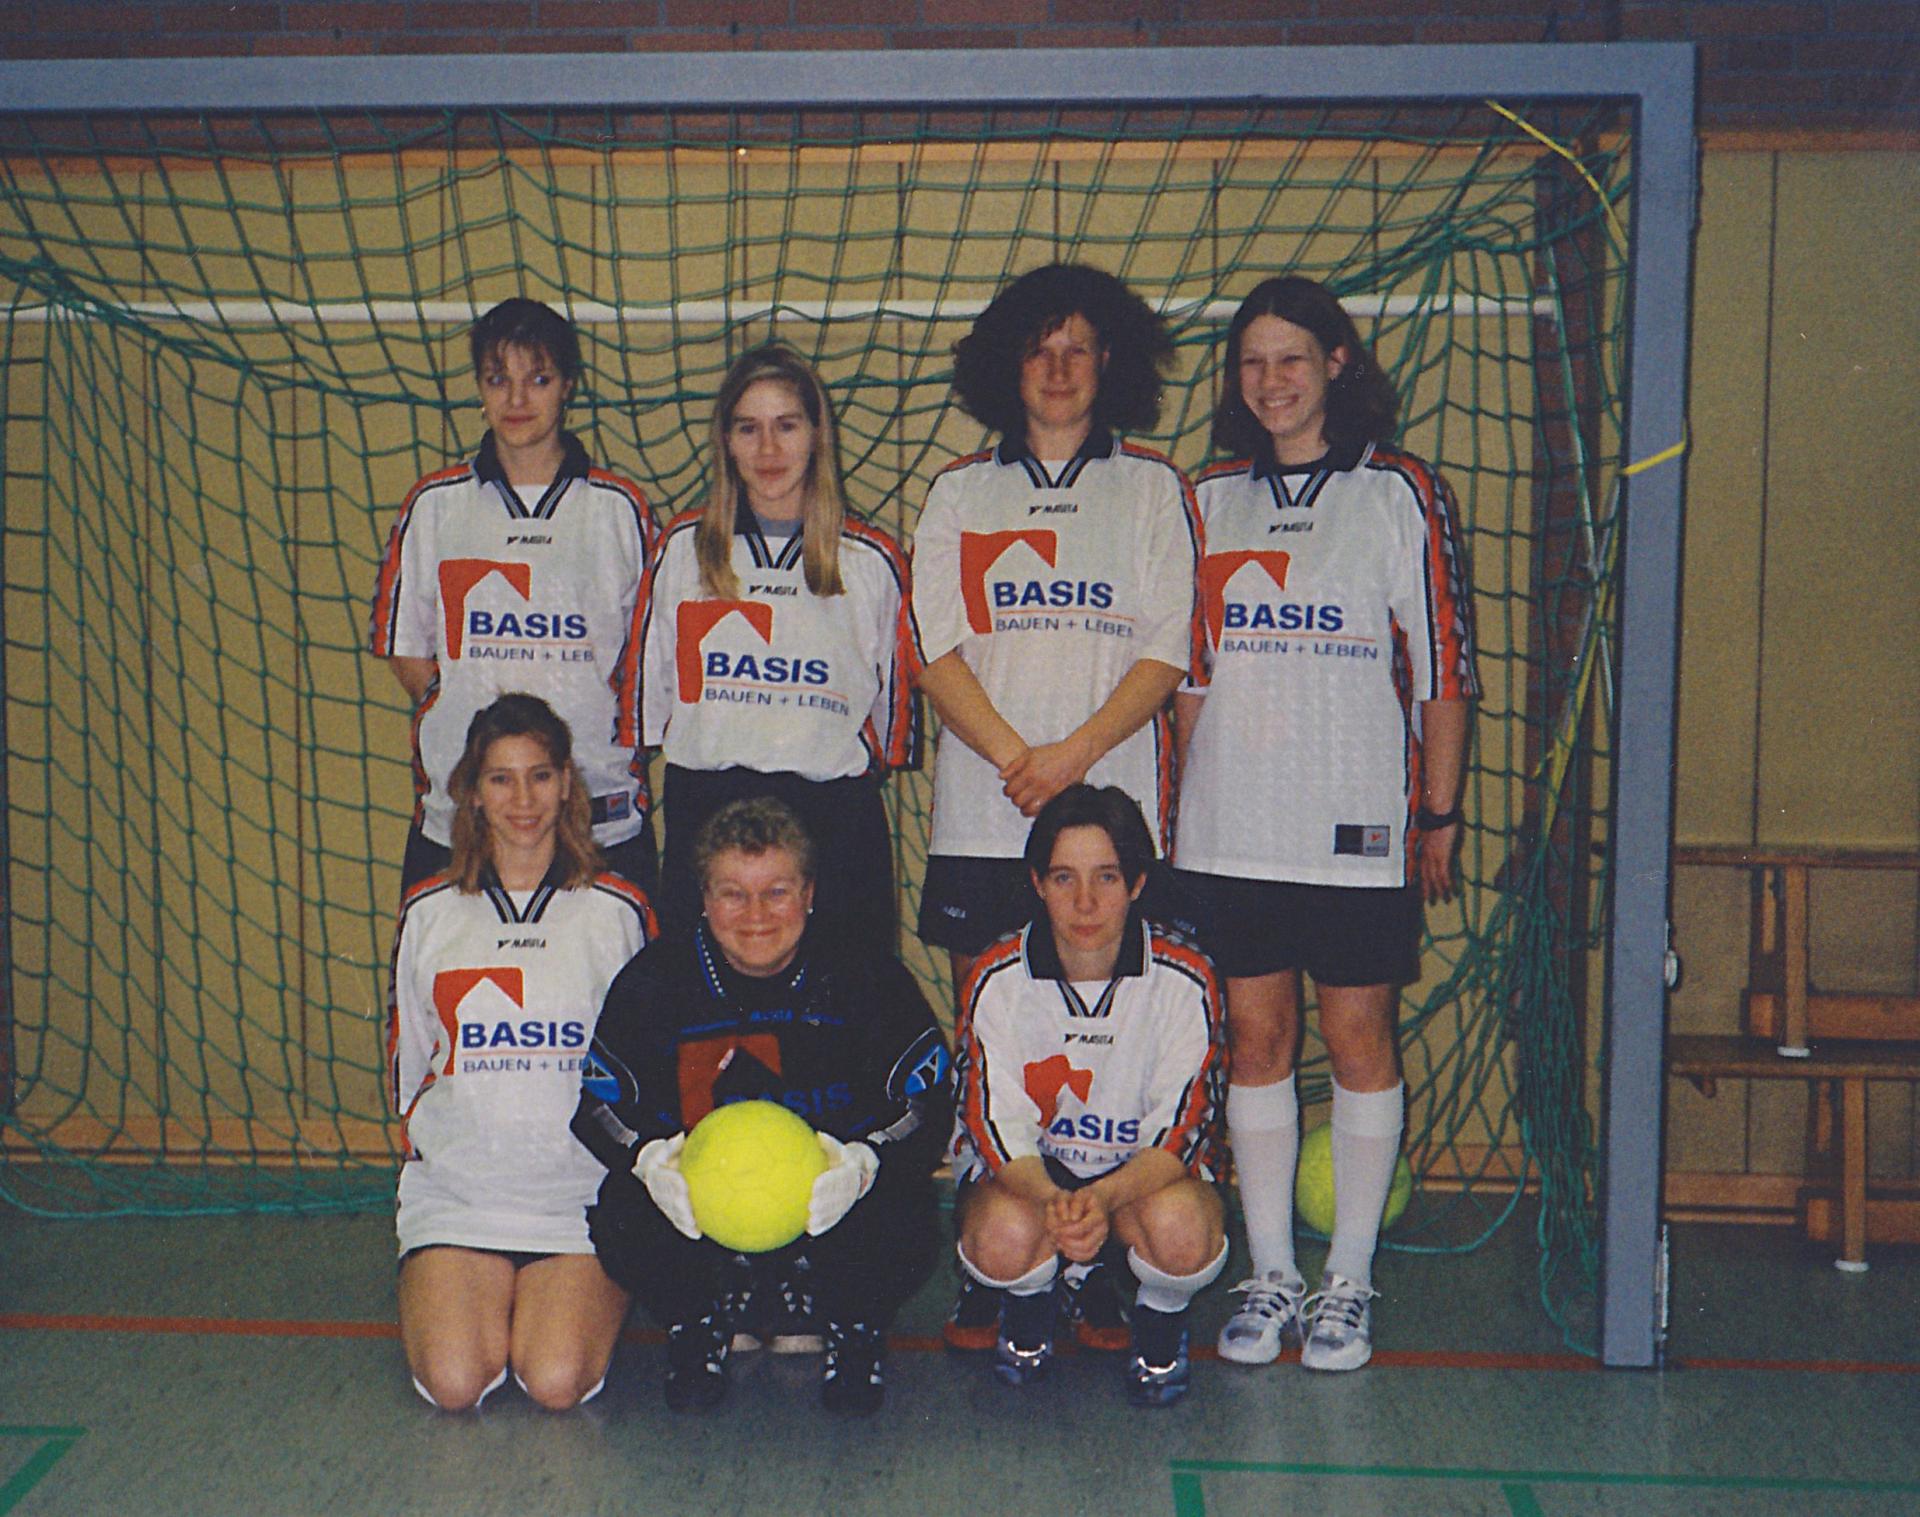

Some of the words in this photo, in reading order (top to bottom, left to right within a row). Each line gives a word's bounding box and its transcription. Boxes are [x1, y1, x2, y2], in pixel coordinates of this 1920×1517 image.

[993, 580, 1114, 609] BASIS
[469, 610, 588, 639] BASIS
[995, 618, 1060, 633] BAUEN
[1066, 619, 1078, 630] +
[1224, 603, 1344, 632] BASIS
[469, 646, 535, 661] BAUEN
[542, 651, 555, 661] +
[1223, 639, 1288, 654] BAUEN
[1296, 644, 1308, 654] +
[1313, 642, 1378, 660] LEBEN
[706, 652, 829, 685] BASIS
[705, 688, 772, 705] BAUEN
[780, 696, 791, 706] +
[798, 694, 849, 716] LEBEN
[461, 1021, 585, 1049] BASIS
[463, 1058, 531, 1074] BAUEN
[538, 1061, 551, 1072] +
